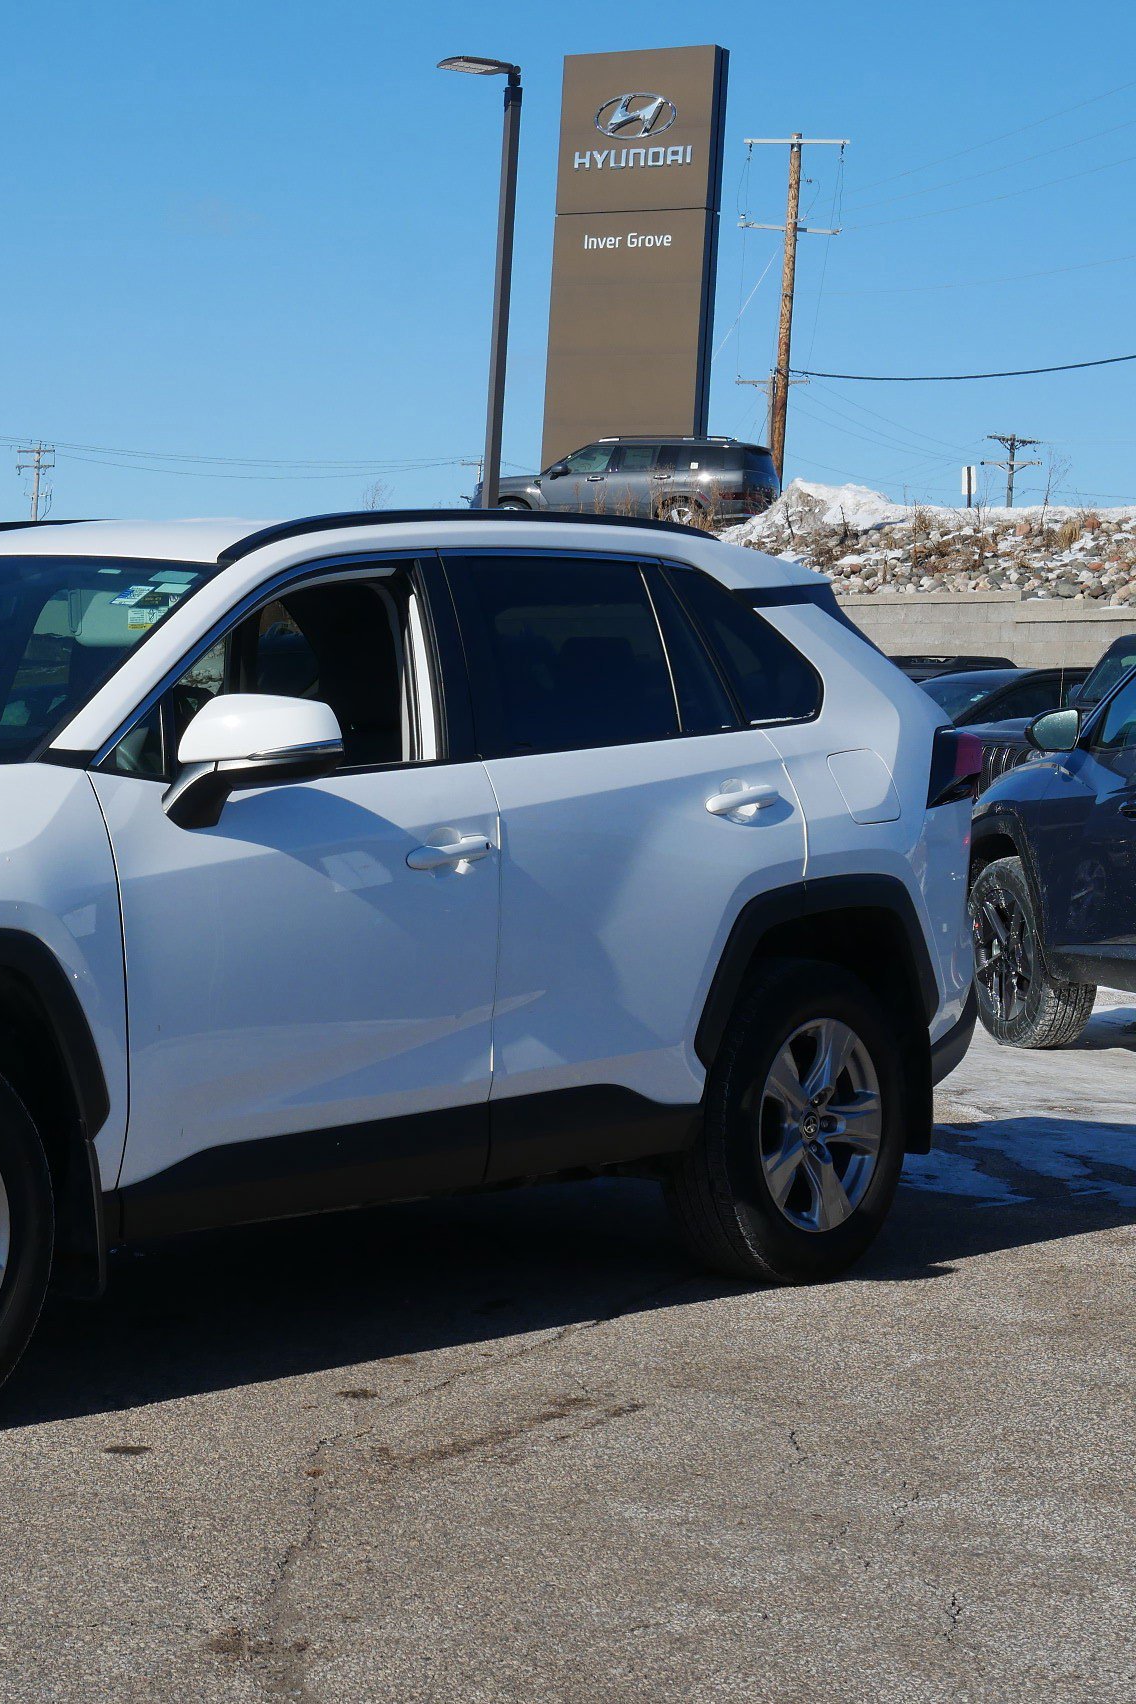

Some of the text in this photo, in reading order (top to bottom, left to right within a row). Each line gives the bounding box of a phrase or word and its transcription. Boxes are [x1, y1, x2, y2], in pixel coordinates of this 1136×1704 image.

[574, 145, 692, 169] HYUNDAI
[584, 232, 672, 249] Inver Grove
